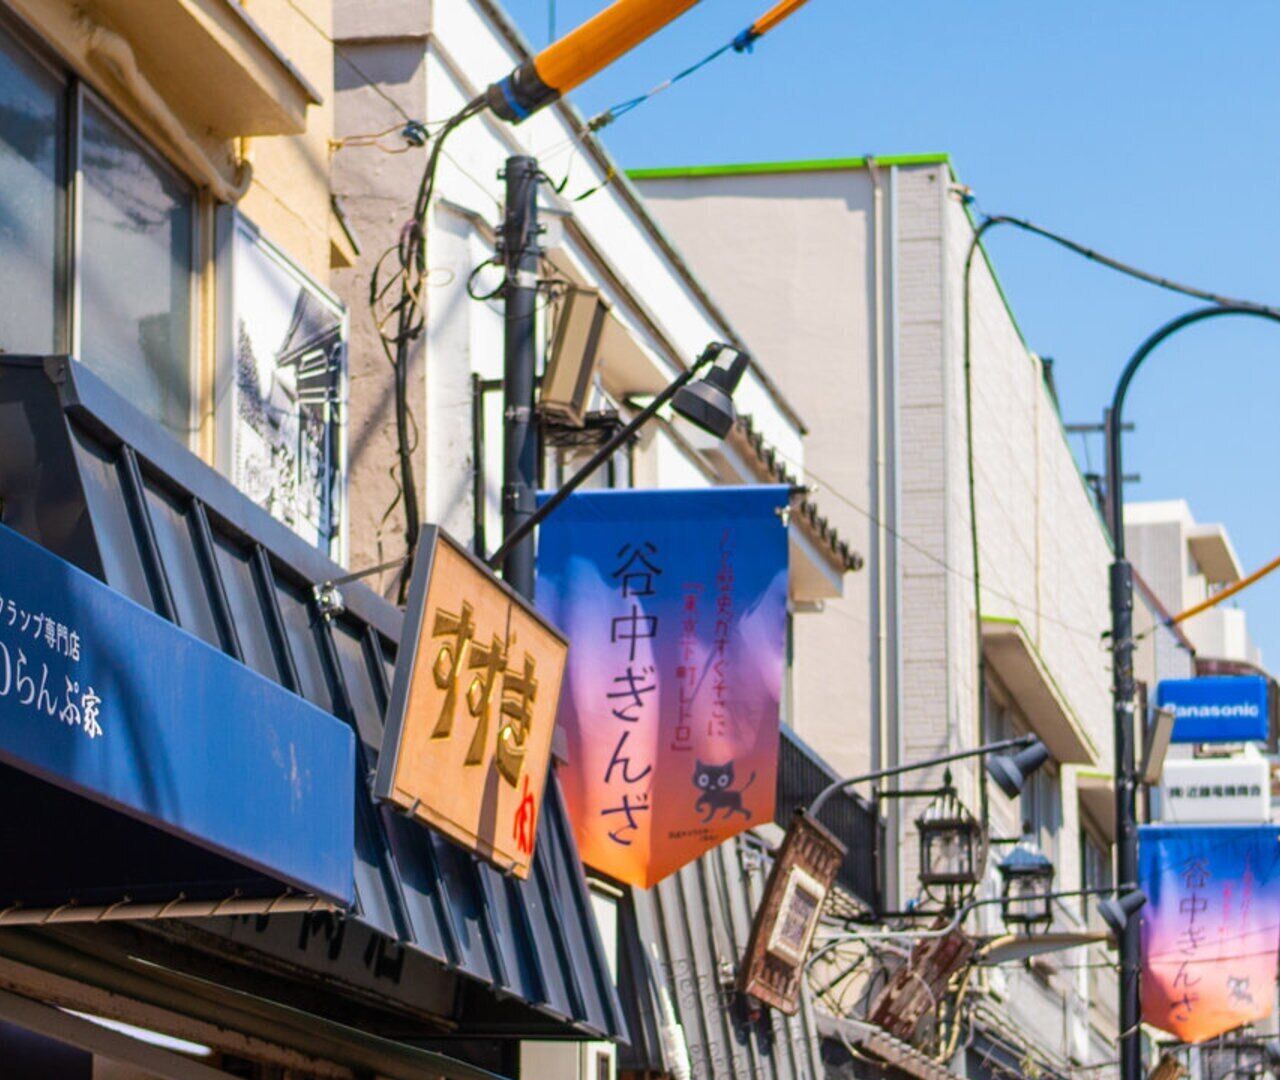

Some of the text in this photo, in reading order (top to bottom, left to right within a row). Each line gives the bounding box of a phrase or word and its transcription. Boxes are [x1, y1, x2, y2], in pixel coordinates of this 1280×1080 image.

[600, 540, 663, 847] 谷中ぎんざ
[1163, 702, 1260, 718] Panasonic
[1170, 857, 1212, 1023] 谷中ぎんざ
